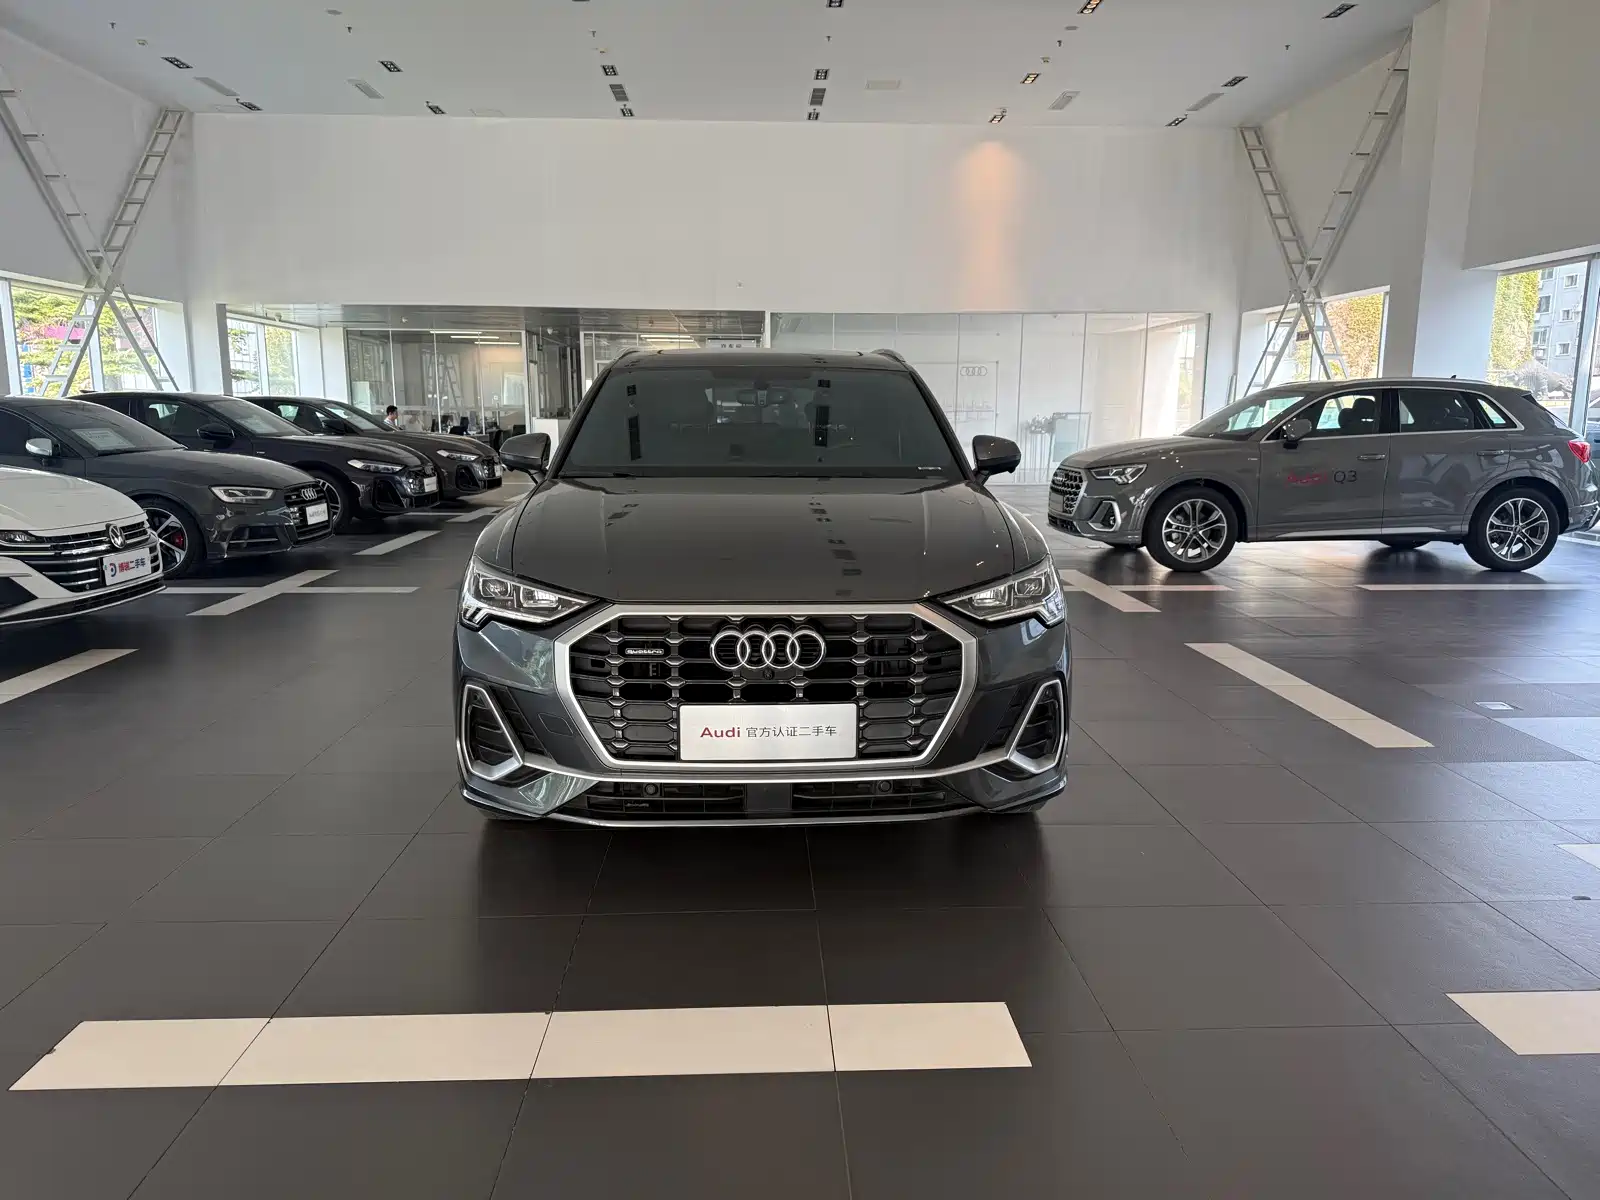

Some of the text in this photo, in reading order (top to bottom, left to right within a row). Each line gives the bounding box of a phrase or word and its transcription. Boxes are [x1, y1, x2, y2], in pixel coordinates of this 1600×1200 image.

[1333, 469, 1357, 484] Q3
[700, 725, 837, 738] Audi 官方认证二手车
